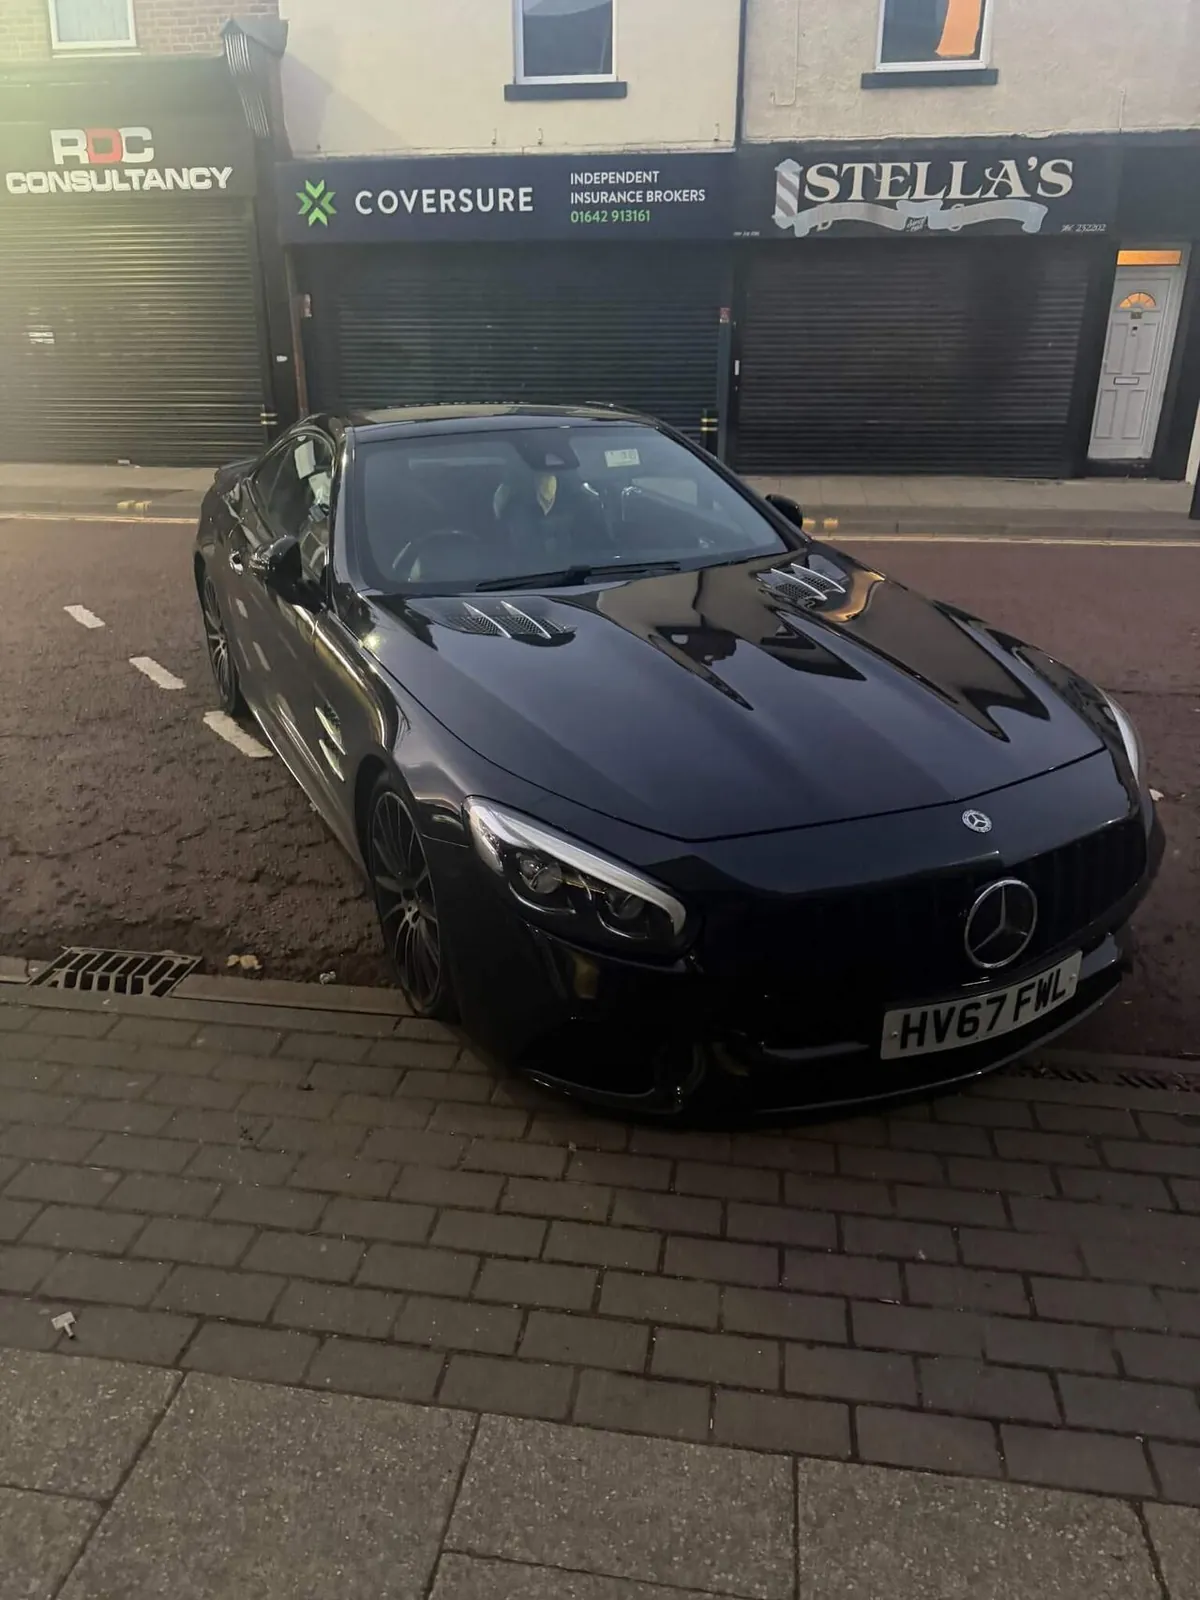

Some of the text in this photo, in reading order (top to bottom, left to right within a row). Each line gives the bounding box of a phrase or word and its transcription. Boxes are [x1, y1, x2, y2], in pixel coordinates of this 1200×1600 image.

[51, 127, 154, 164] RDC
[6, 167, 233, 193] CONSULTANCY
[570, 171, 660, 185] INDEPENDENT
[803, 158, 1075, 201] STELLA'S
[354, 187, 534, 215] COVERSURE
[570, 189, 706, 204] INSURANCE BROKERS
[570, 209, 651, 223] 01642 913161
[900, 968, 1066, 1047] HV67 FWL
